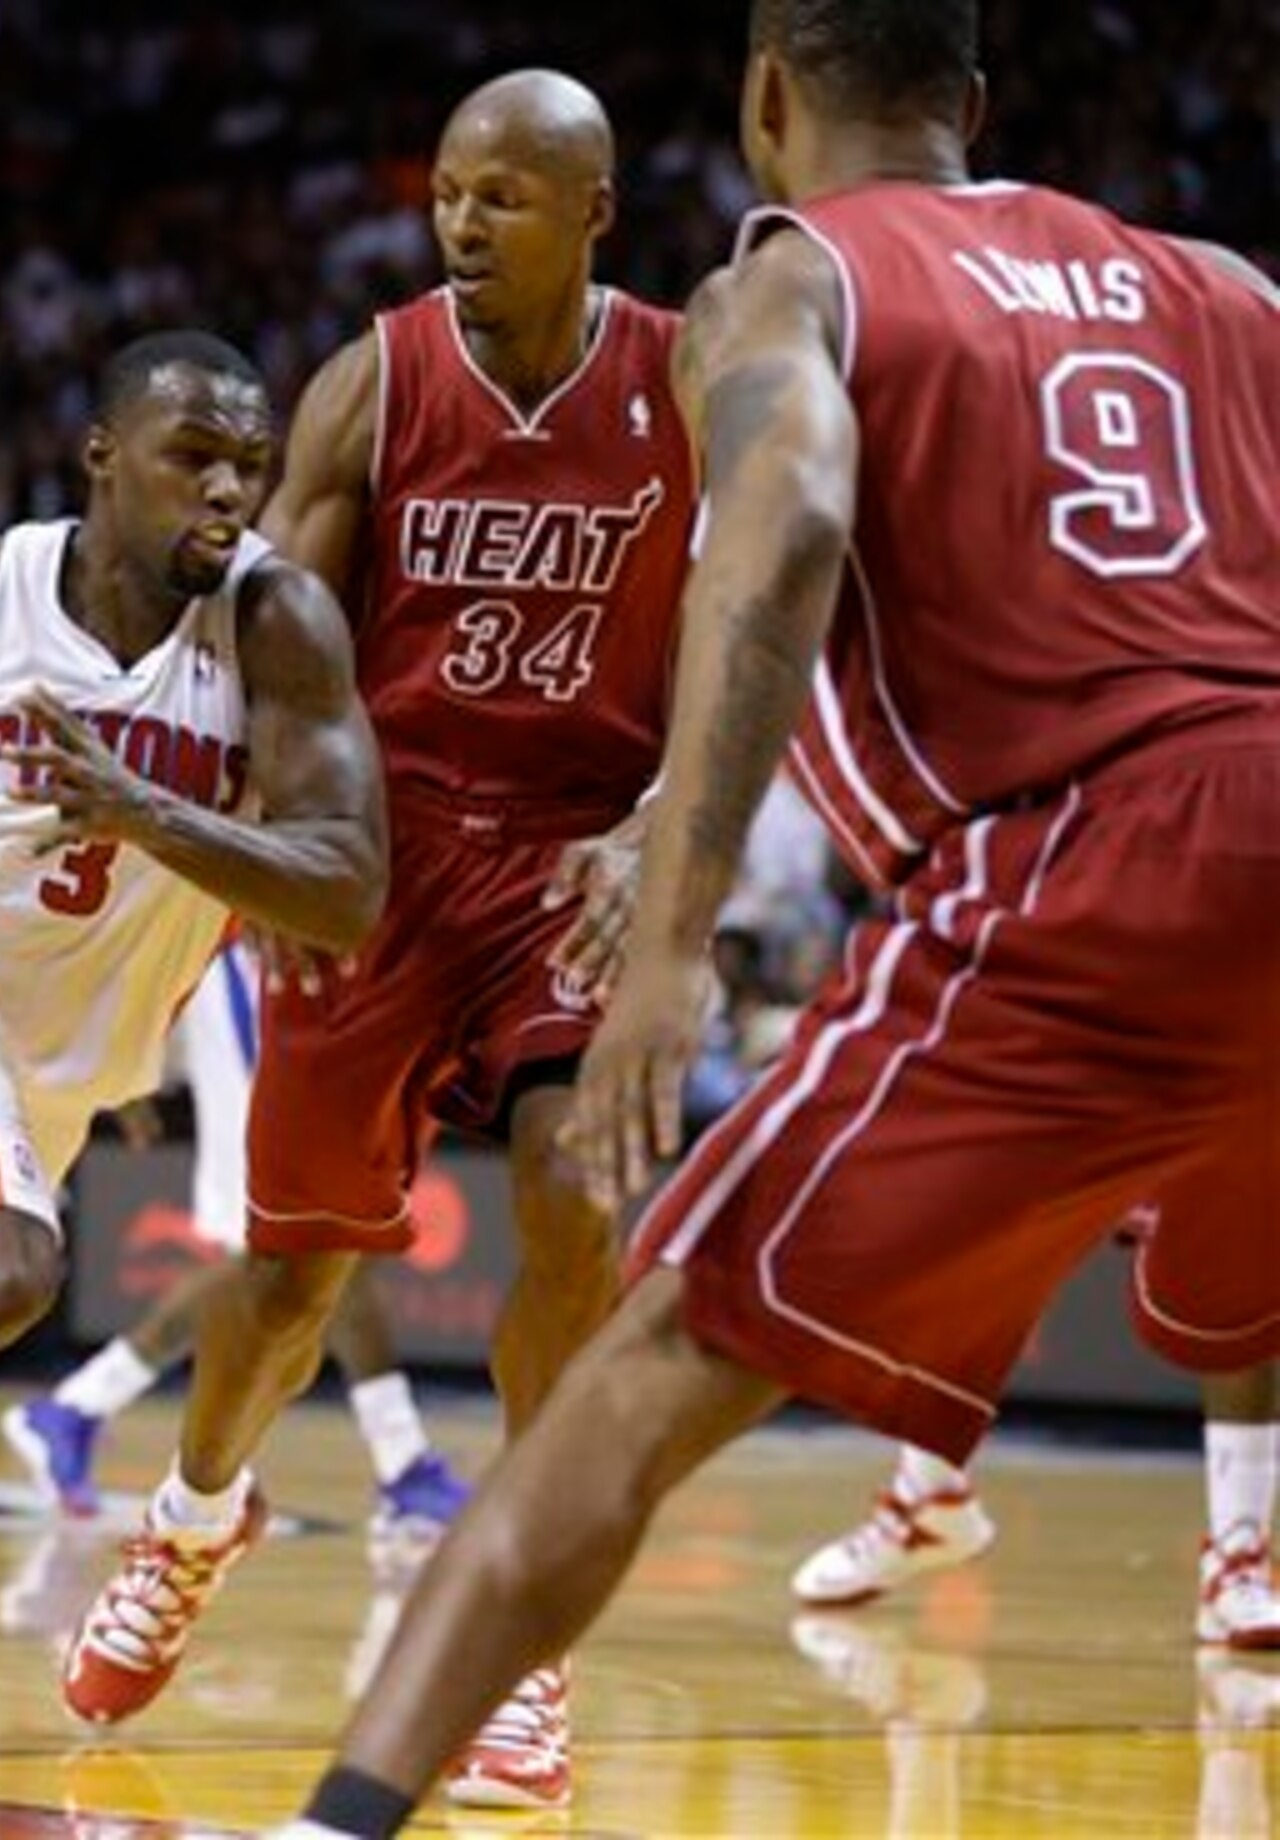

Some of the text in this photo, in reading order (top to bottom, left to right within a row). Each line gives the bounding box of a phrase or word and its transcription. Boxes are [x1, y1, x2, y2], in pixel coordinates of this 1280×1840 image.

[1040, 350, 1209, 577] 9
[400, 476, 664, 593] HEAT
[440, 598, 602, 702] 34
[38, 838, 120, 917] 3
